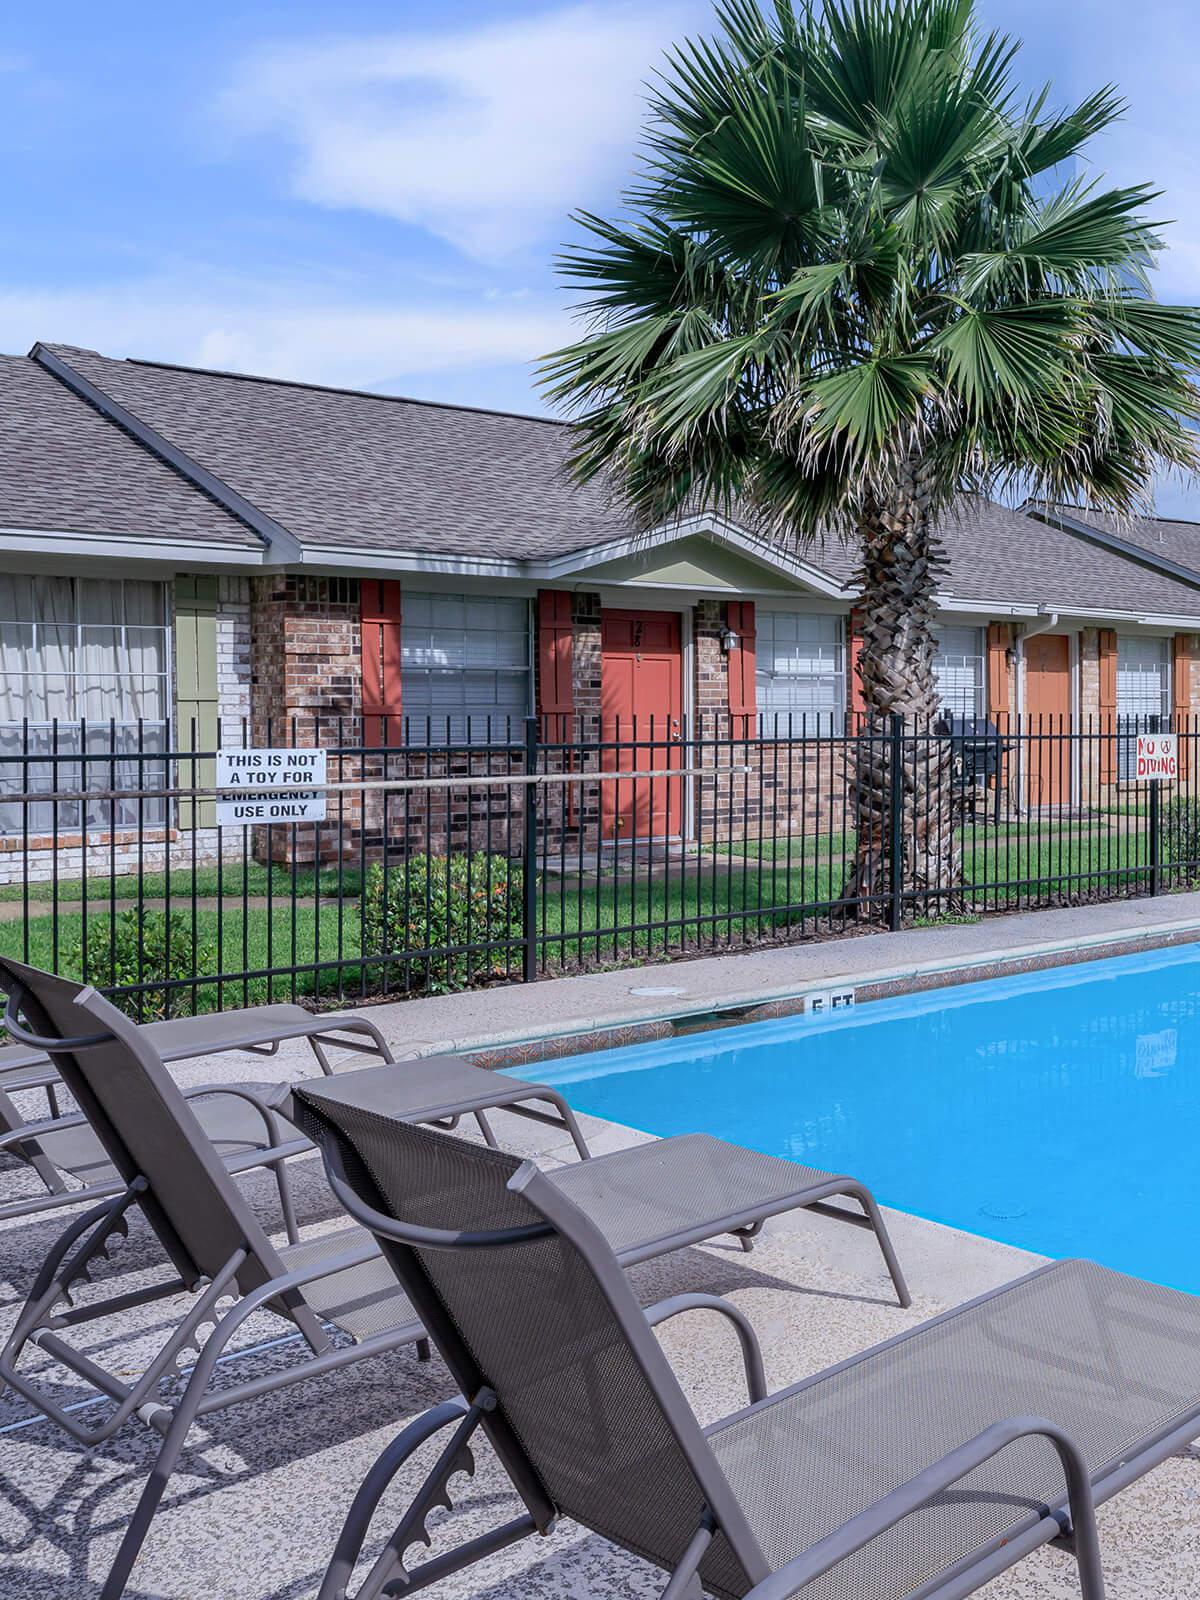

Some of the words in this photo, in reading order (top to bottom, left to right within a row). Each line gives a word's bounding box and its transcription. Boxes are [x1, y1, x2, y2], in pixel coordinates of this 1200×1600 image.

[226, 755, 262, 767] THIS
[268, 755, 282, 767] IS
[287, 755, 318, 766] NOT
[1138, 757, 1175, 775] DIVING
[230, 772, 240, 783] A
[246, 772, 277, 783] TOY
[283, 771, 313, 783] FOR
[234, 806, 264, 817] USE
[270, 805, 308, 816] ONLY
